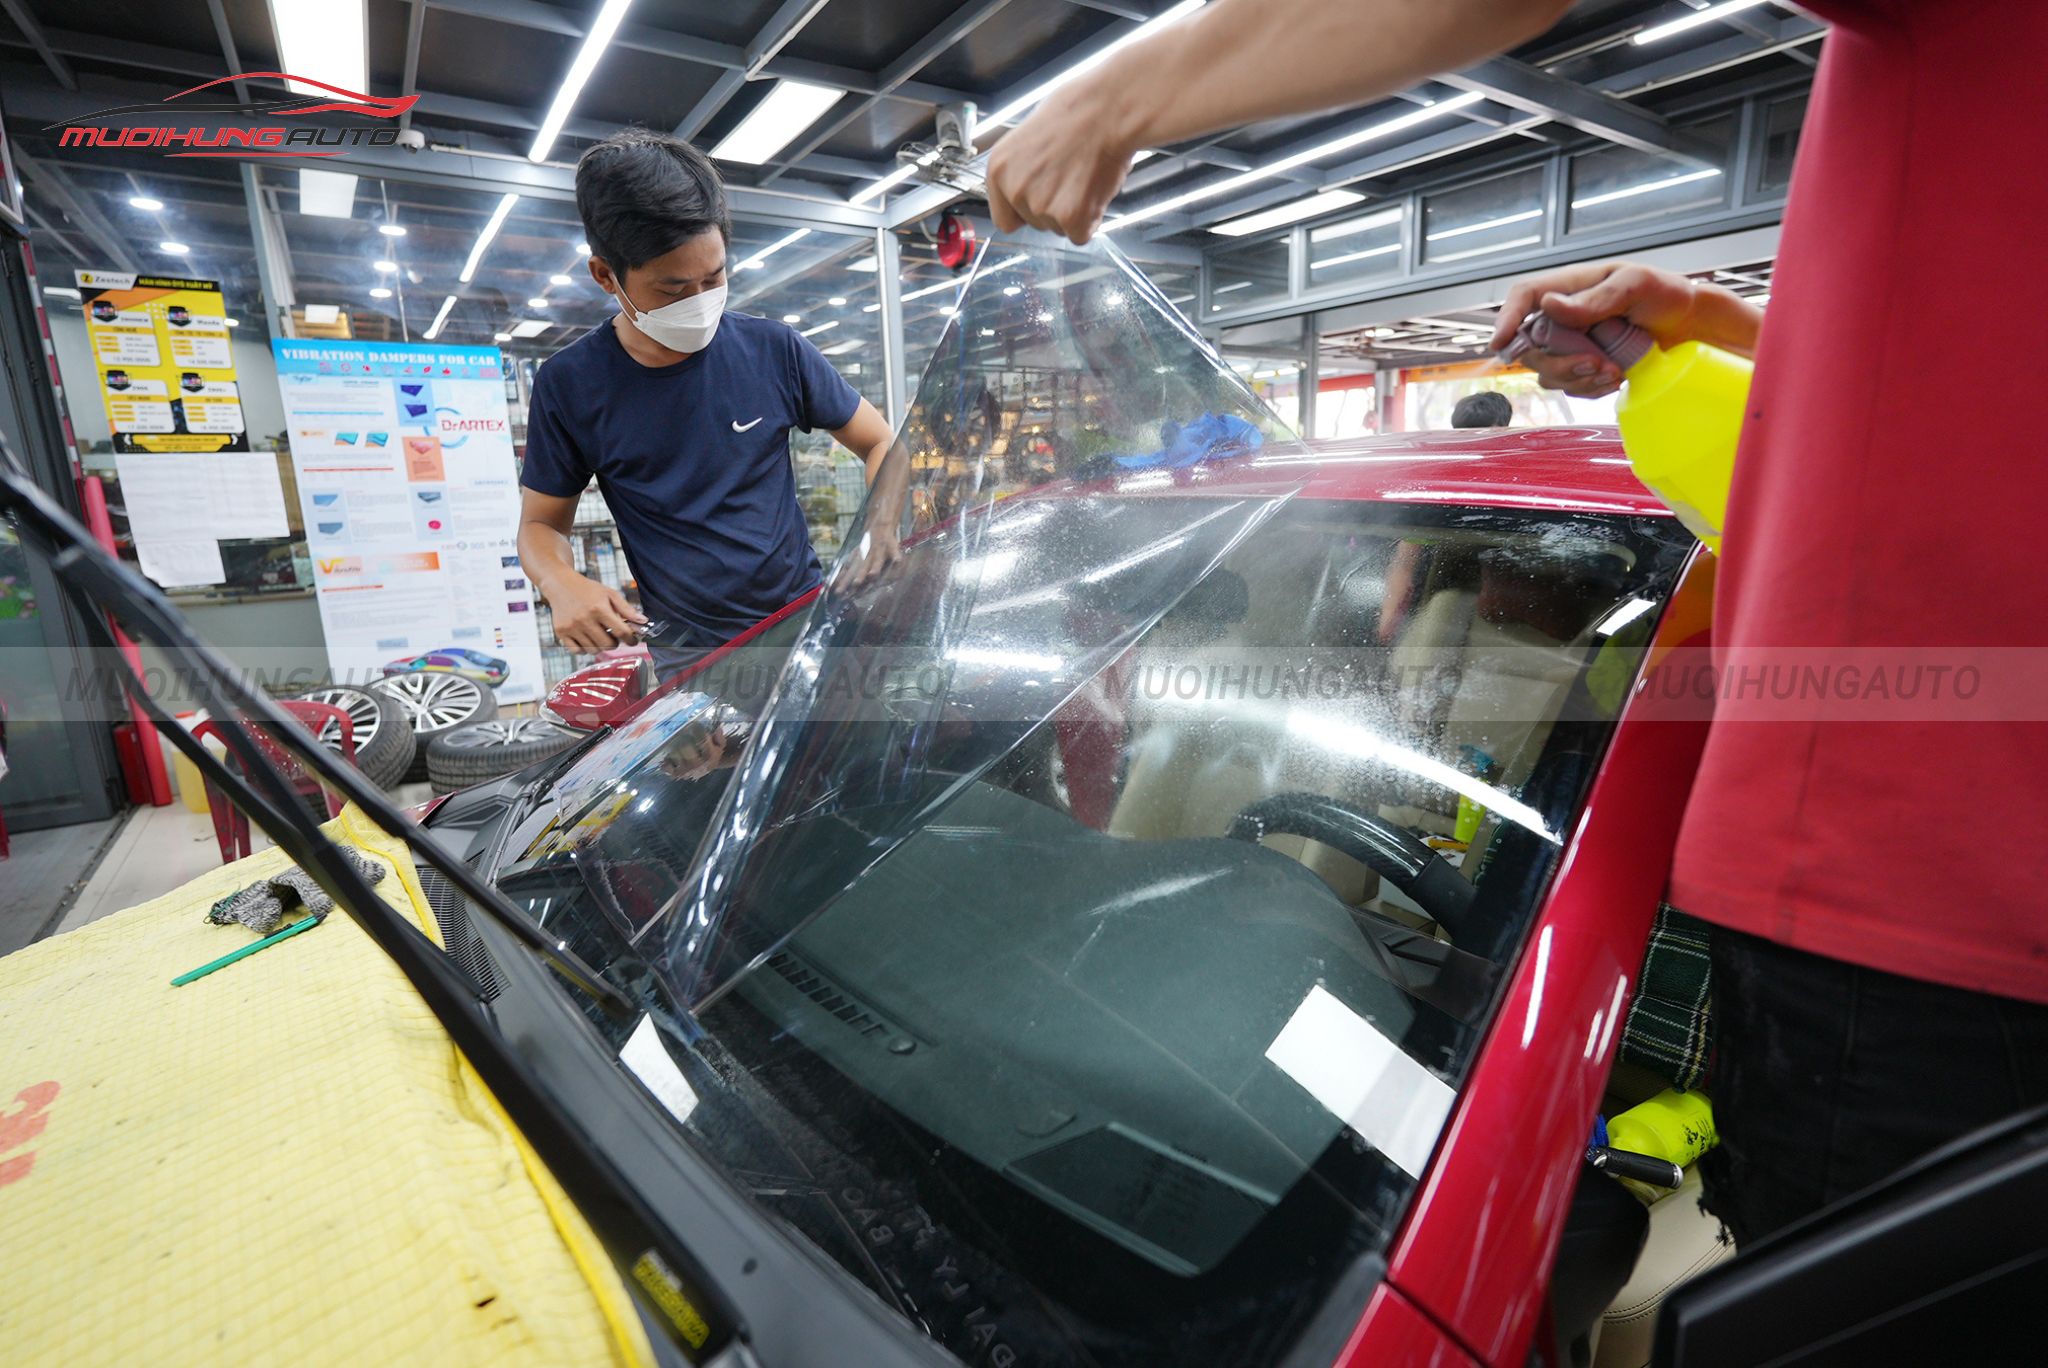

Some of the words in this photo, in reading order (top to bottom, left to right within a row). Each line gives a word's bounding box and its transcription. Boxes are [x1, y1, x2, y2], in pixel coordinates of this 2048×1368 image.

[281, 348, 365, 361] VIBRATION
[368, 351, 435, 364] DAMPERS
[438, 354, 466, 365] FOR
[468, 355, 496, 366] CAR
